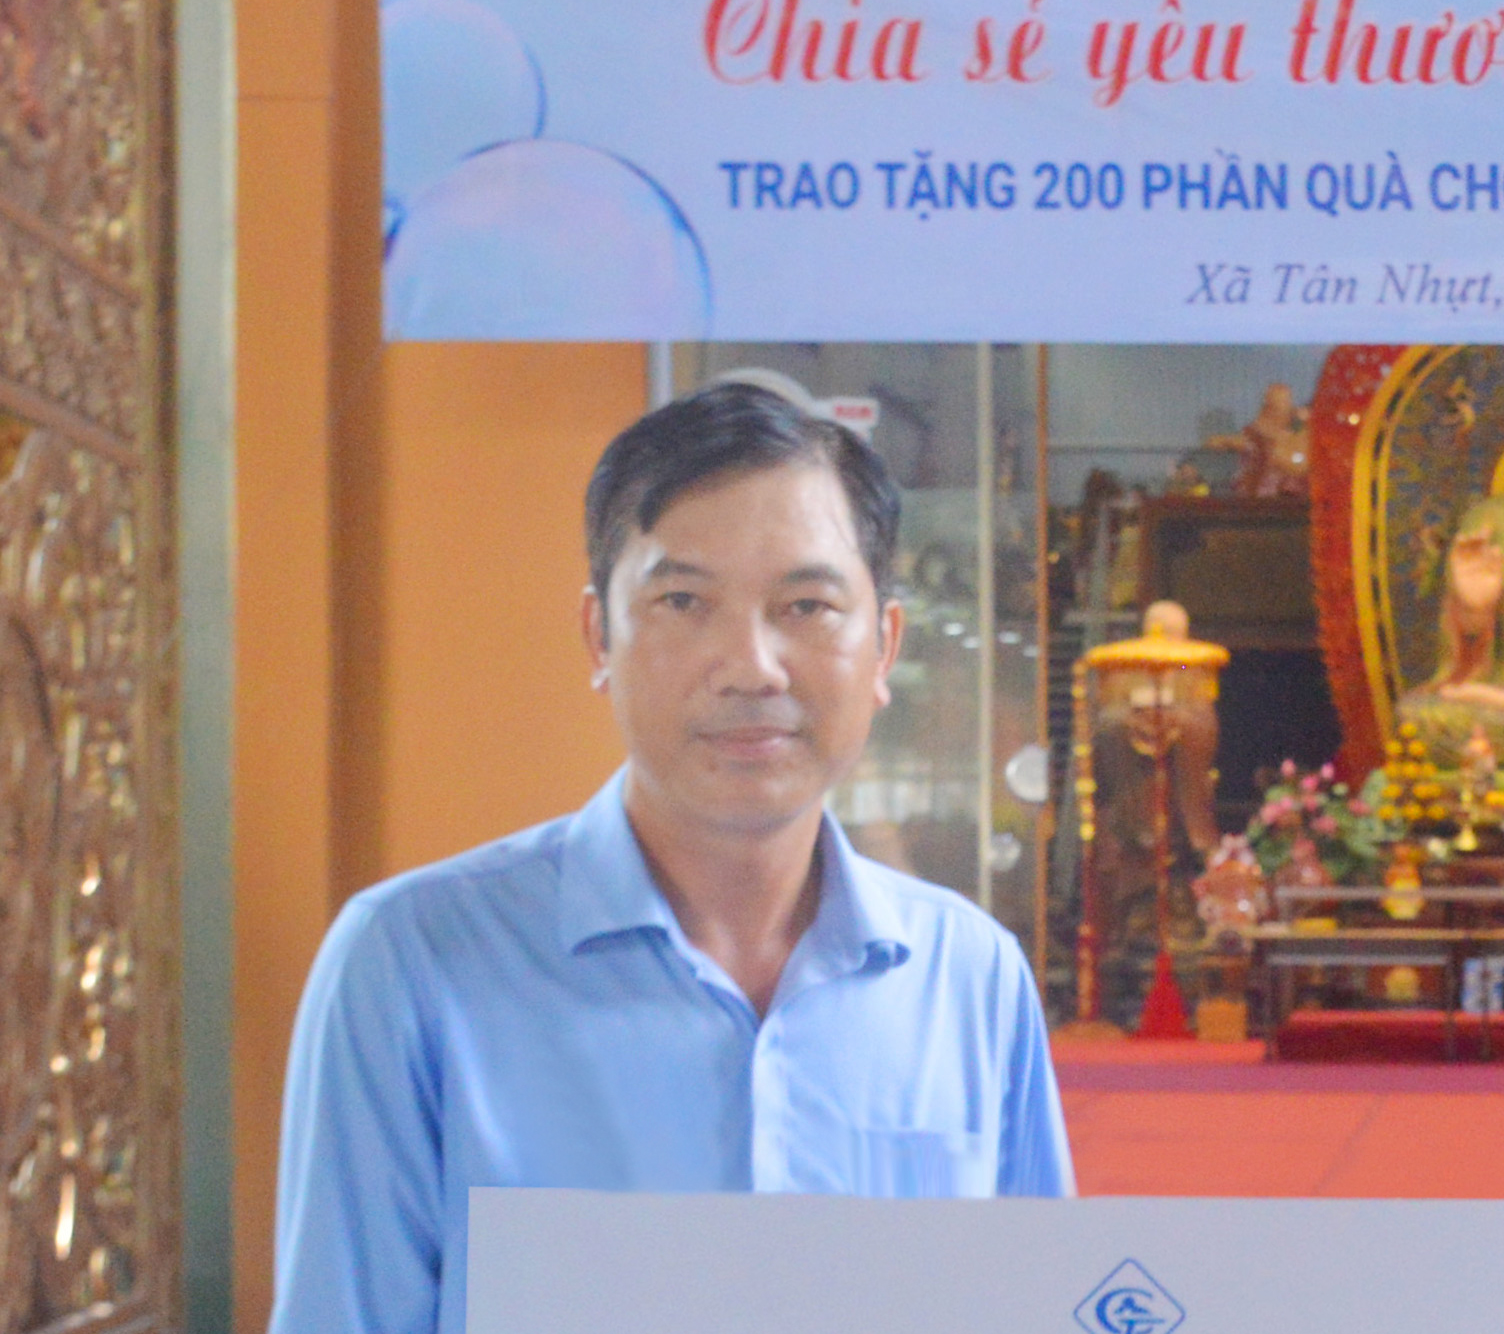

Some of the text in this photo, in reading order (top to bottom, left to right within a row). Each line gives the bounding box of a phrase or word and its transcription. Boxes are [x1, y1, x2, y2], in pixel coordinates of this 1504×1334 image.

[717, 160, 861, 210] TRAO
[874, 150, 1017, 220] TẶNG
[1033, 160, 1126, 211] 200
[1141, 149, 1289, 211] PHẦN
[1304, 149, 1414, 218] QUÀ
[1185, 262, 1252, 305] Xã
[1273, 261, 1359, 305] Tân
[1375, 261, 1504, 315] Nhựt,
